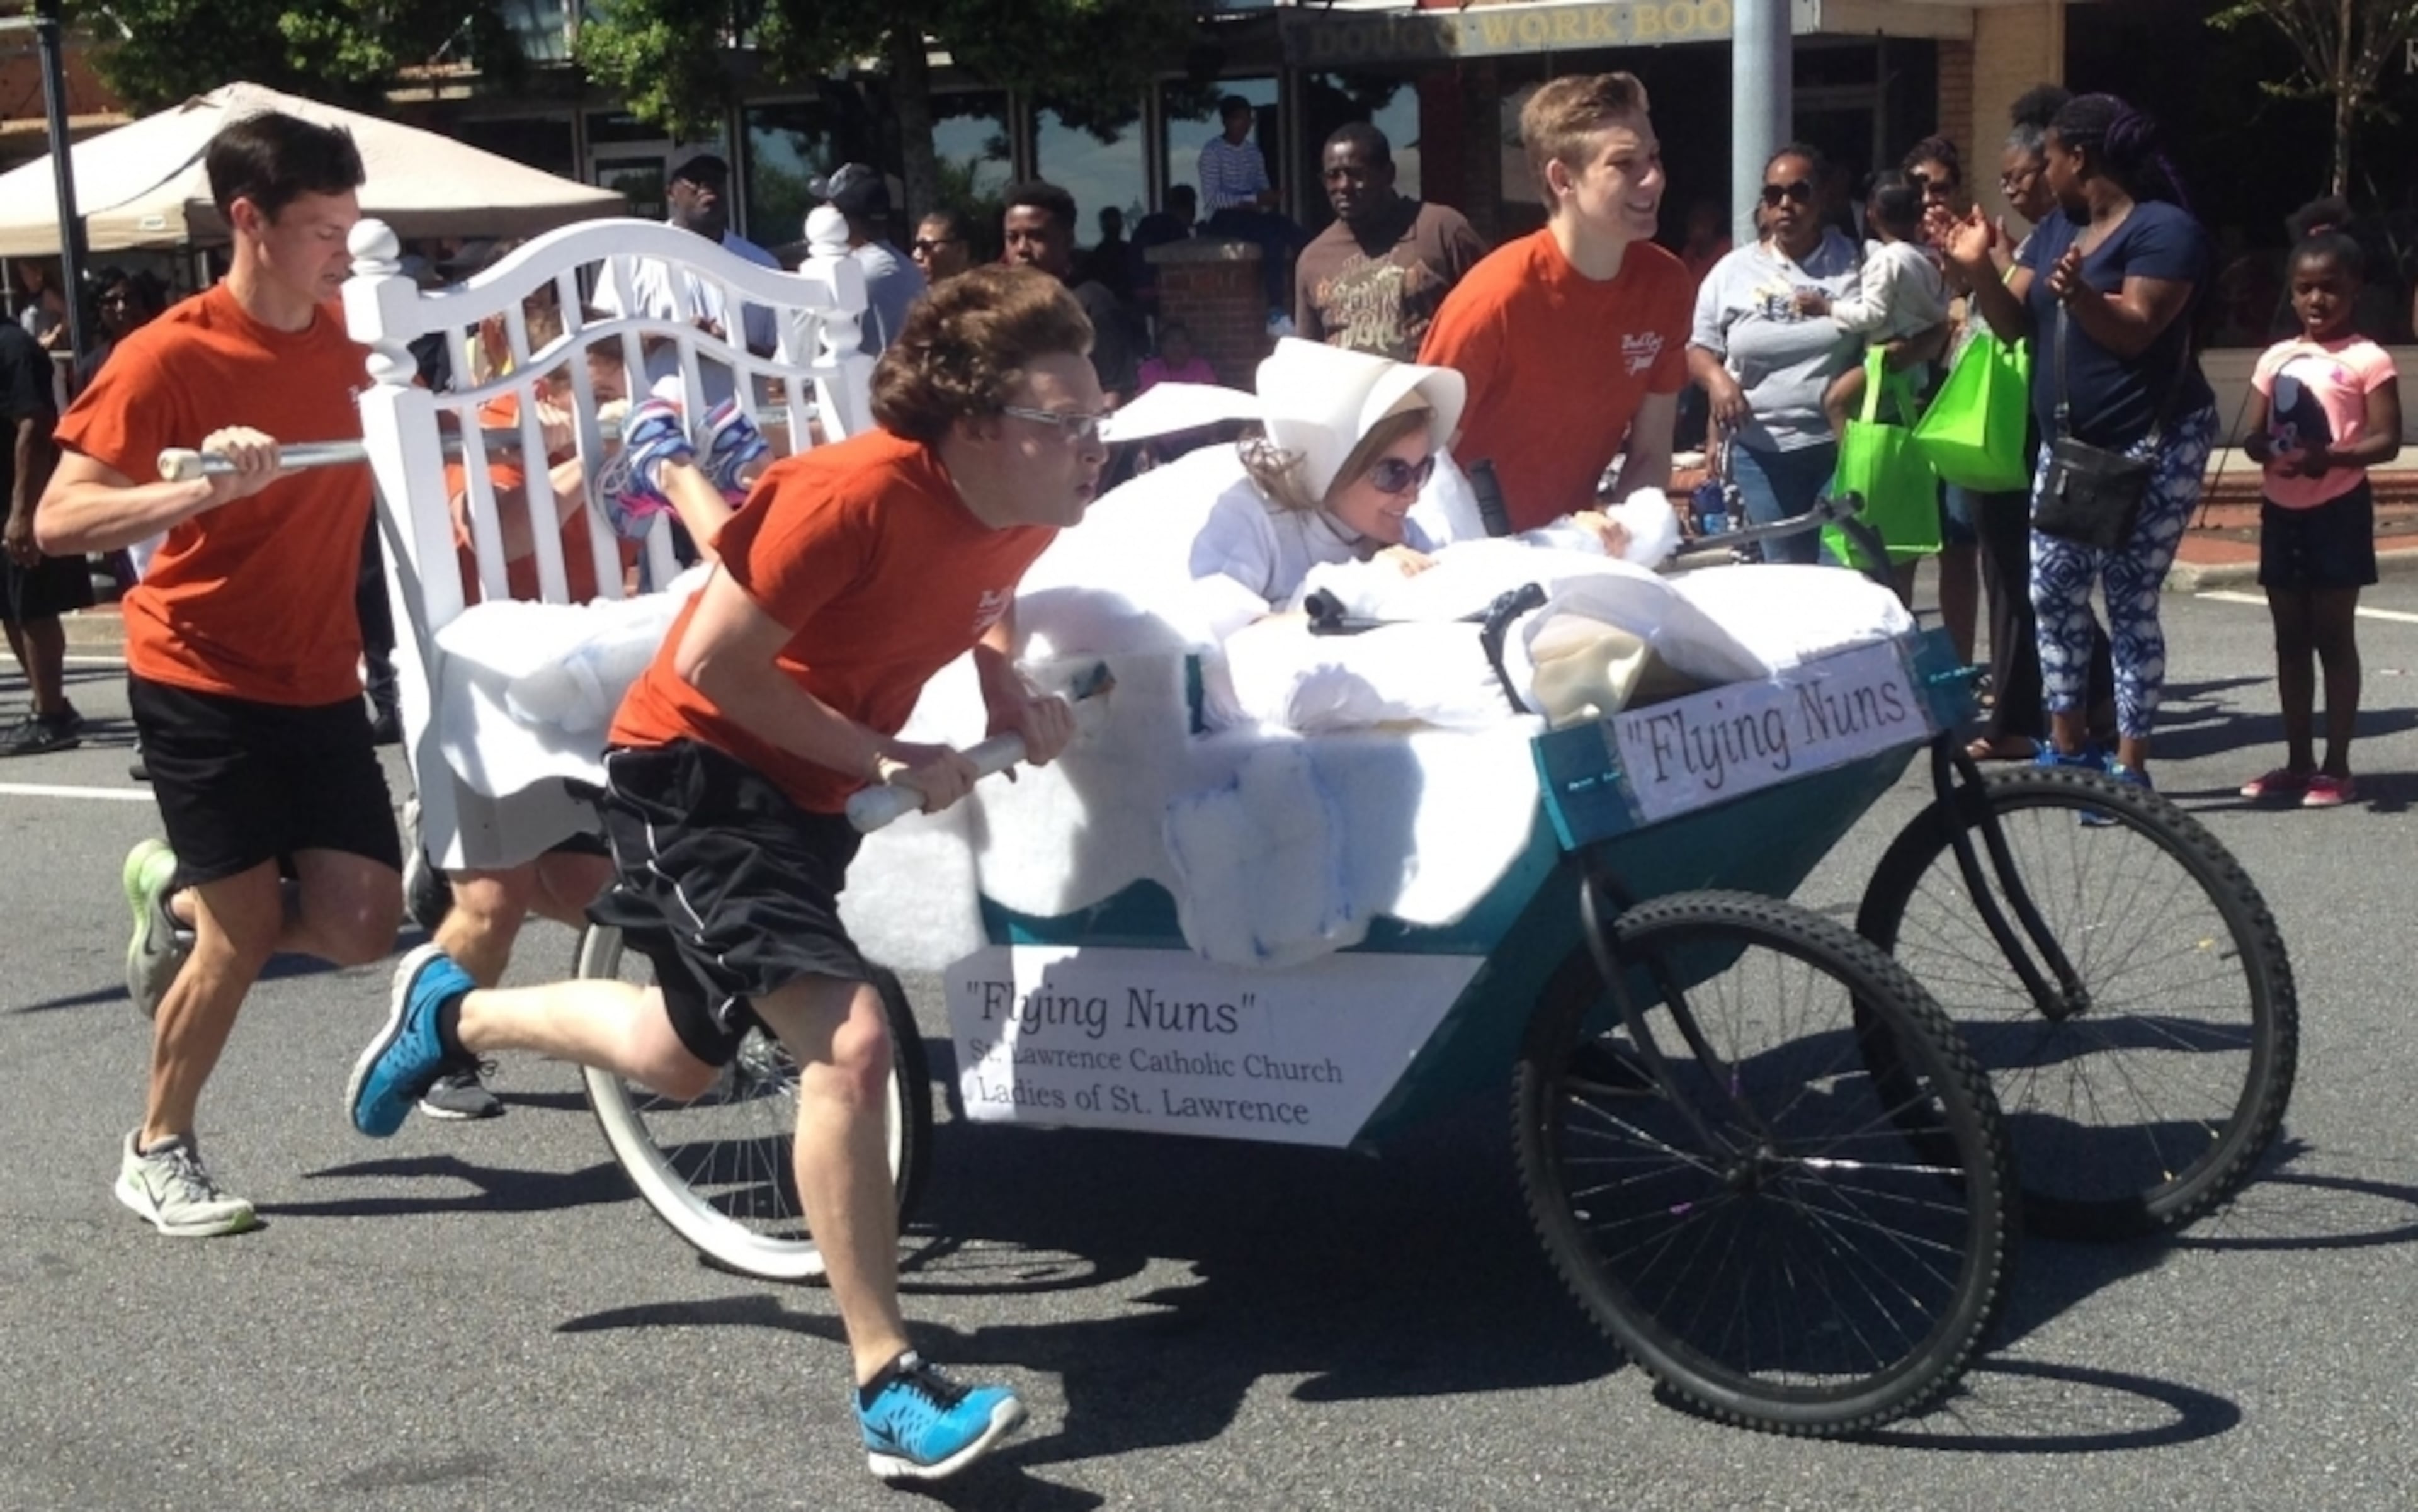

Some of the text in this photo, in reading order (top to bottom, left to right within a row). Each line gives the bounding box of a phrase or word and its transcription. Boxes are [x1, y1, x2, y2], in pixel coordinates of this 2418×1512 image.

[1480, 5, 1618, 47] WORK
[1627, 679, 1906, 790] "Flying Nuns
[966, 980, 1256, 1040] "Flying Nuns"
[969, 1038, 1344, 1084] St. Lawrence Catholic Church
[978, 1076, 1310, 1125] Ladies of St. Lawrence
